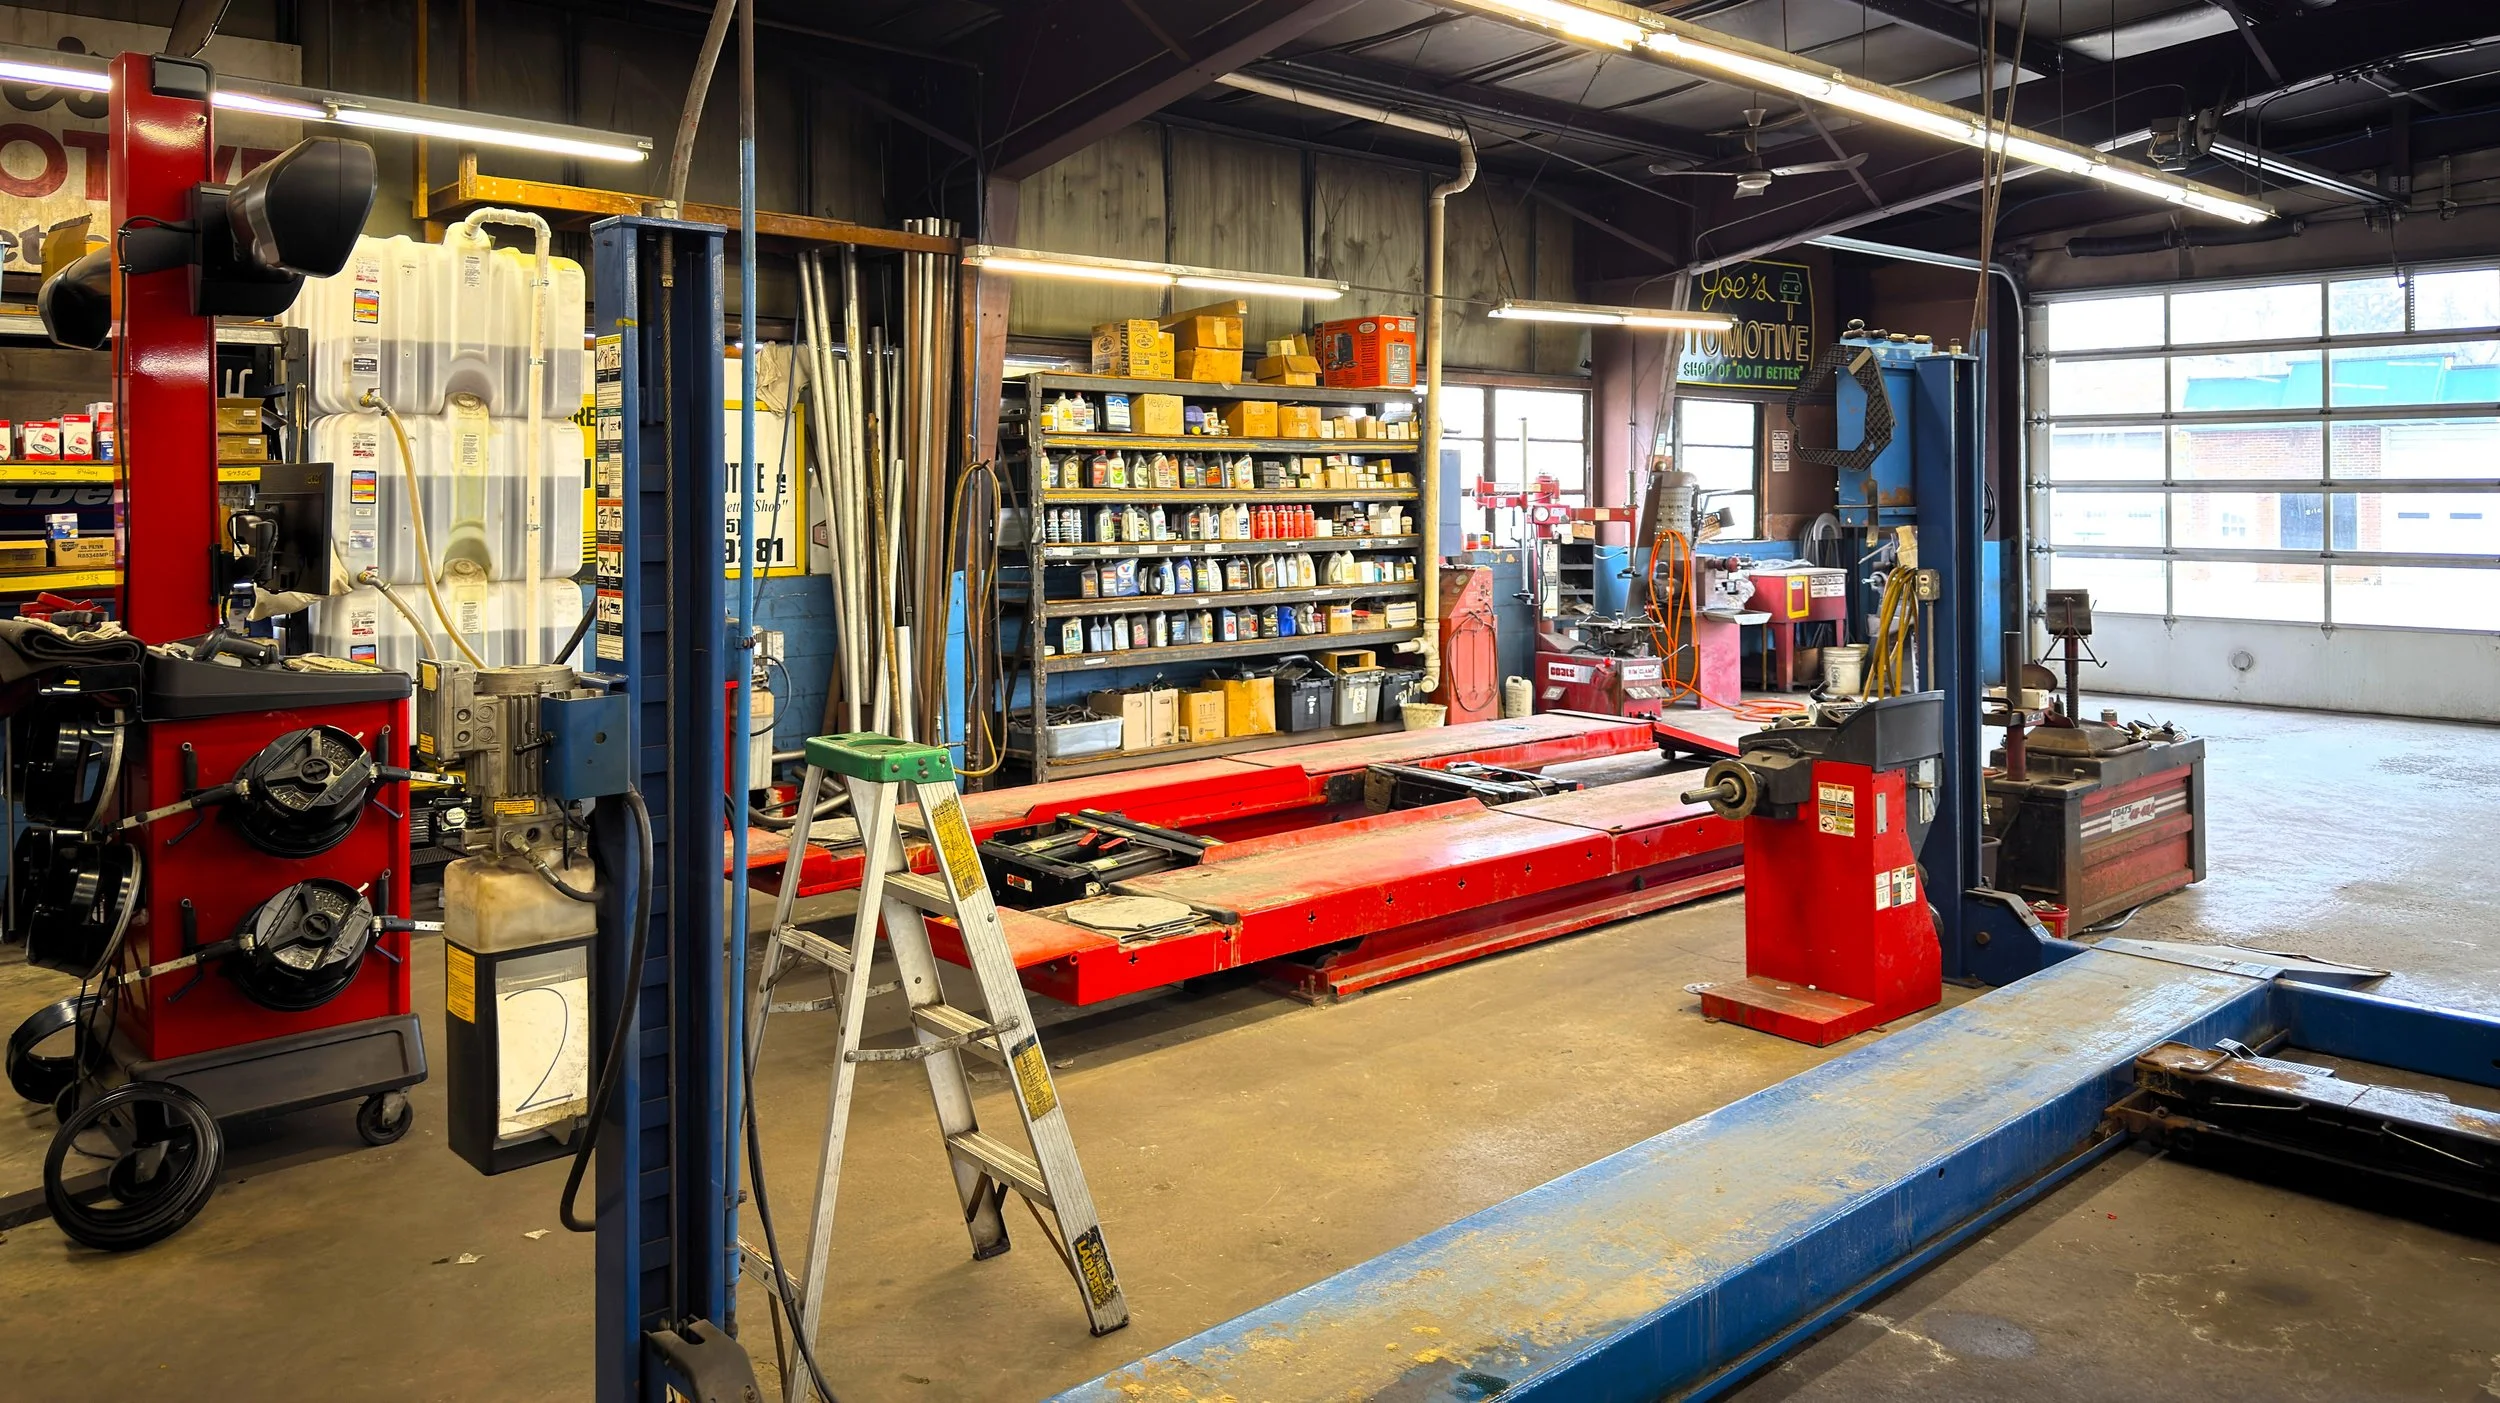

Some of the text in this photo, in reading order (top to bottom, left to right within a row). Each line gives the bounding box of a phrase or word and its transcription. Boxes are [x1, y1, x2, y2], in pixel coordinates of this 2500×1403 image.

[1701, 268, 1775, 311] Joe's
[1681, 320, 1809, 361] TOMOTIVE
[1684, 362, 1712, 377] SHOP
[1718, 363, 1730, 377] OF
[1754, 365, 1762, 379] IT
[504, 987, 573, 1113] 2
